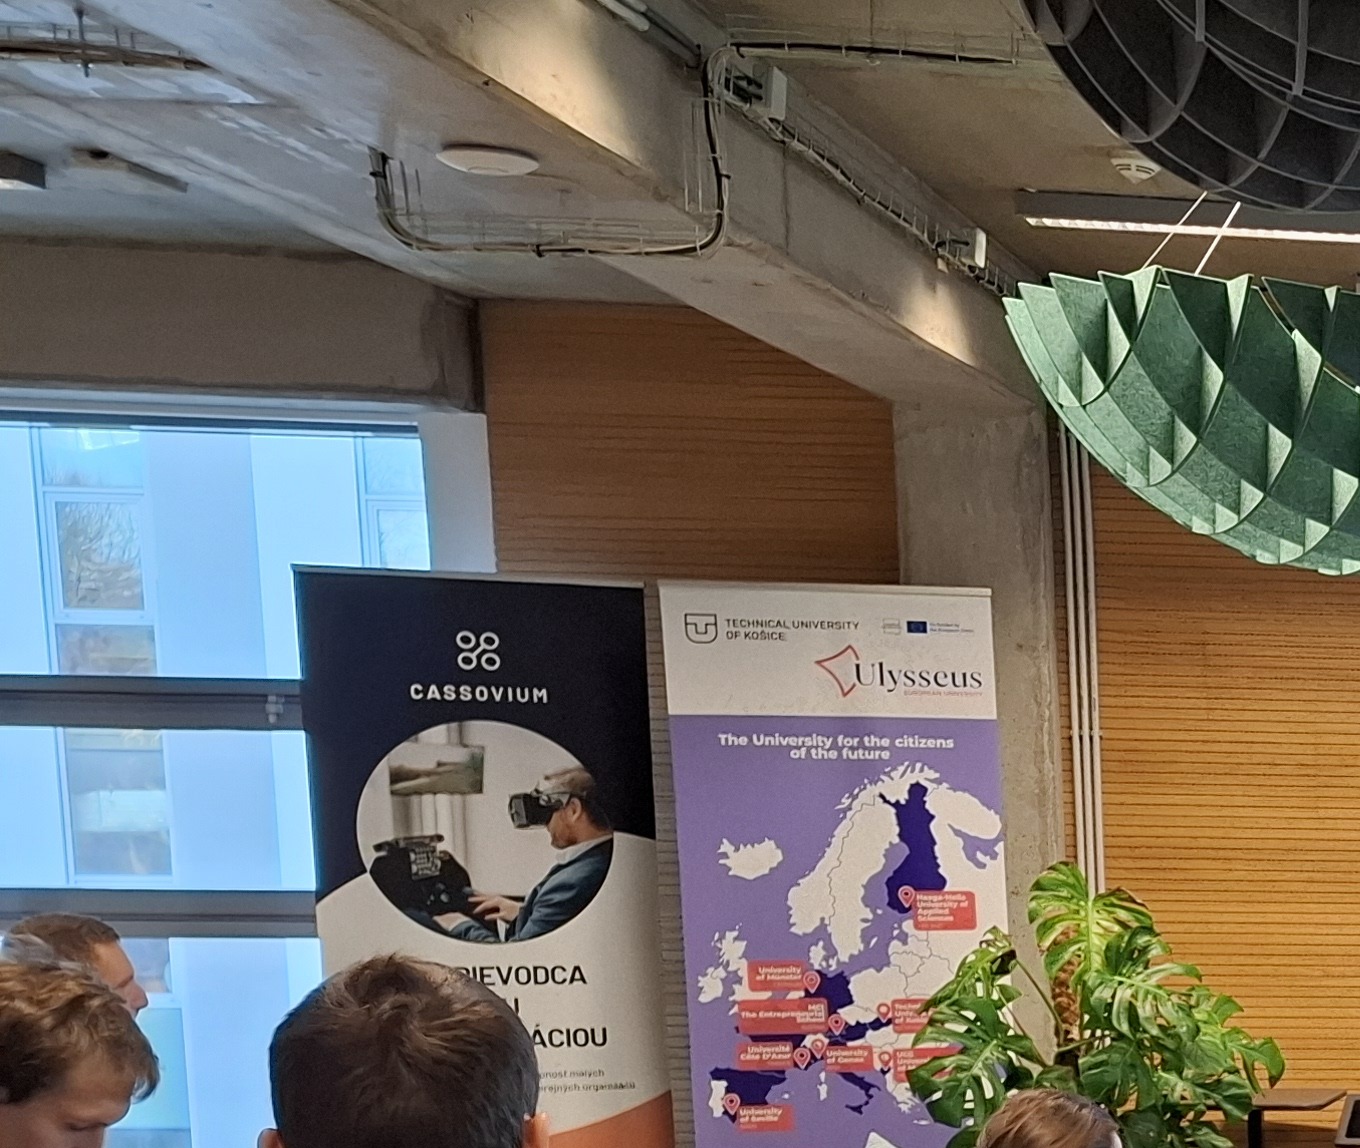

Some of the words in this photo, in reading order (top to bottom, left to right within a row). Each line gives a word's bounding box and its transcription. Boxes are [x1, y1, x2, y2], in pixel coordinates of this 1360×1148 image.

[725, 618, 789, 630] TECHNICAL
[792, 620, 860, 631] UNIVERSITY
[726, 631, 739, 640] OF
[855, 661, 983, 693] Ulysseus
[409, 683, 548, 704] CASSOVIUM
[718, 733, 749, 746] The
[752, 733, 833, 749] University
[837, 734, 860, 747] for
[863, 734, 890, 748] the
[894, 735, 954, 749] citizens
[789, 747, 806, 760] of
[810, 747, 838, 760] the
[842, 748, 890, 760] future
[458, 965, 587, 986] IEVODCA
[532, 1024, 608, 1048] ÁCIOU
